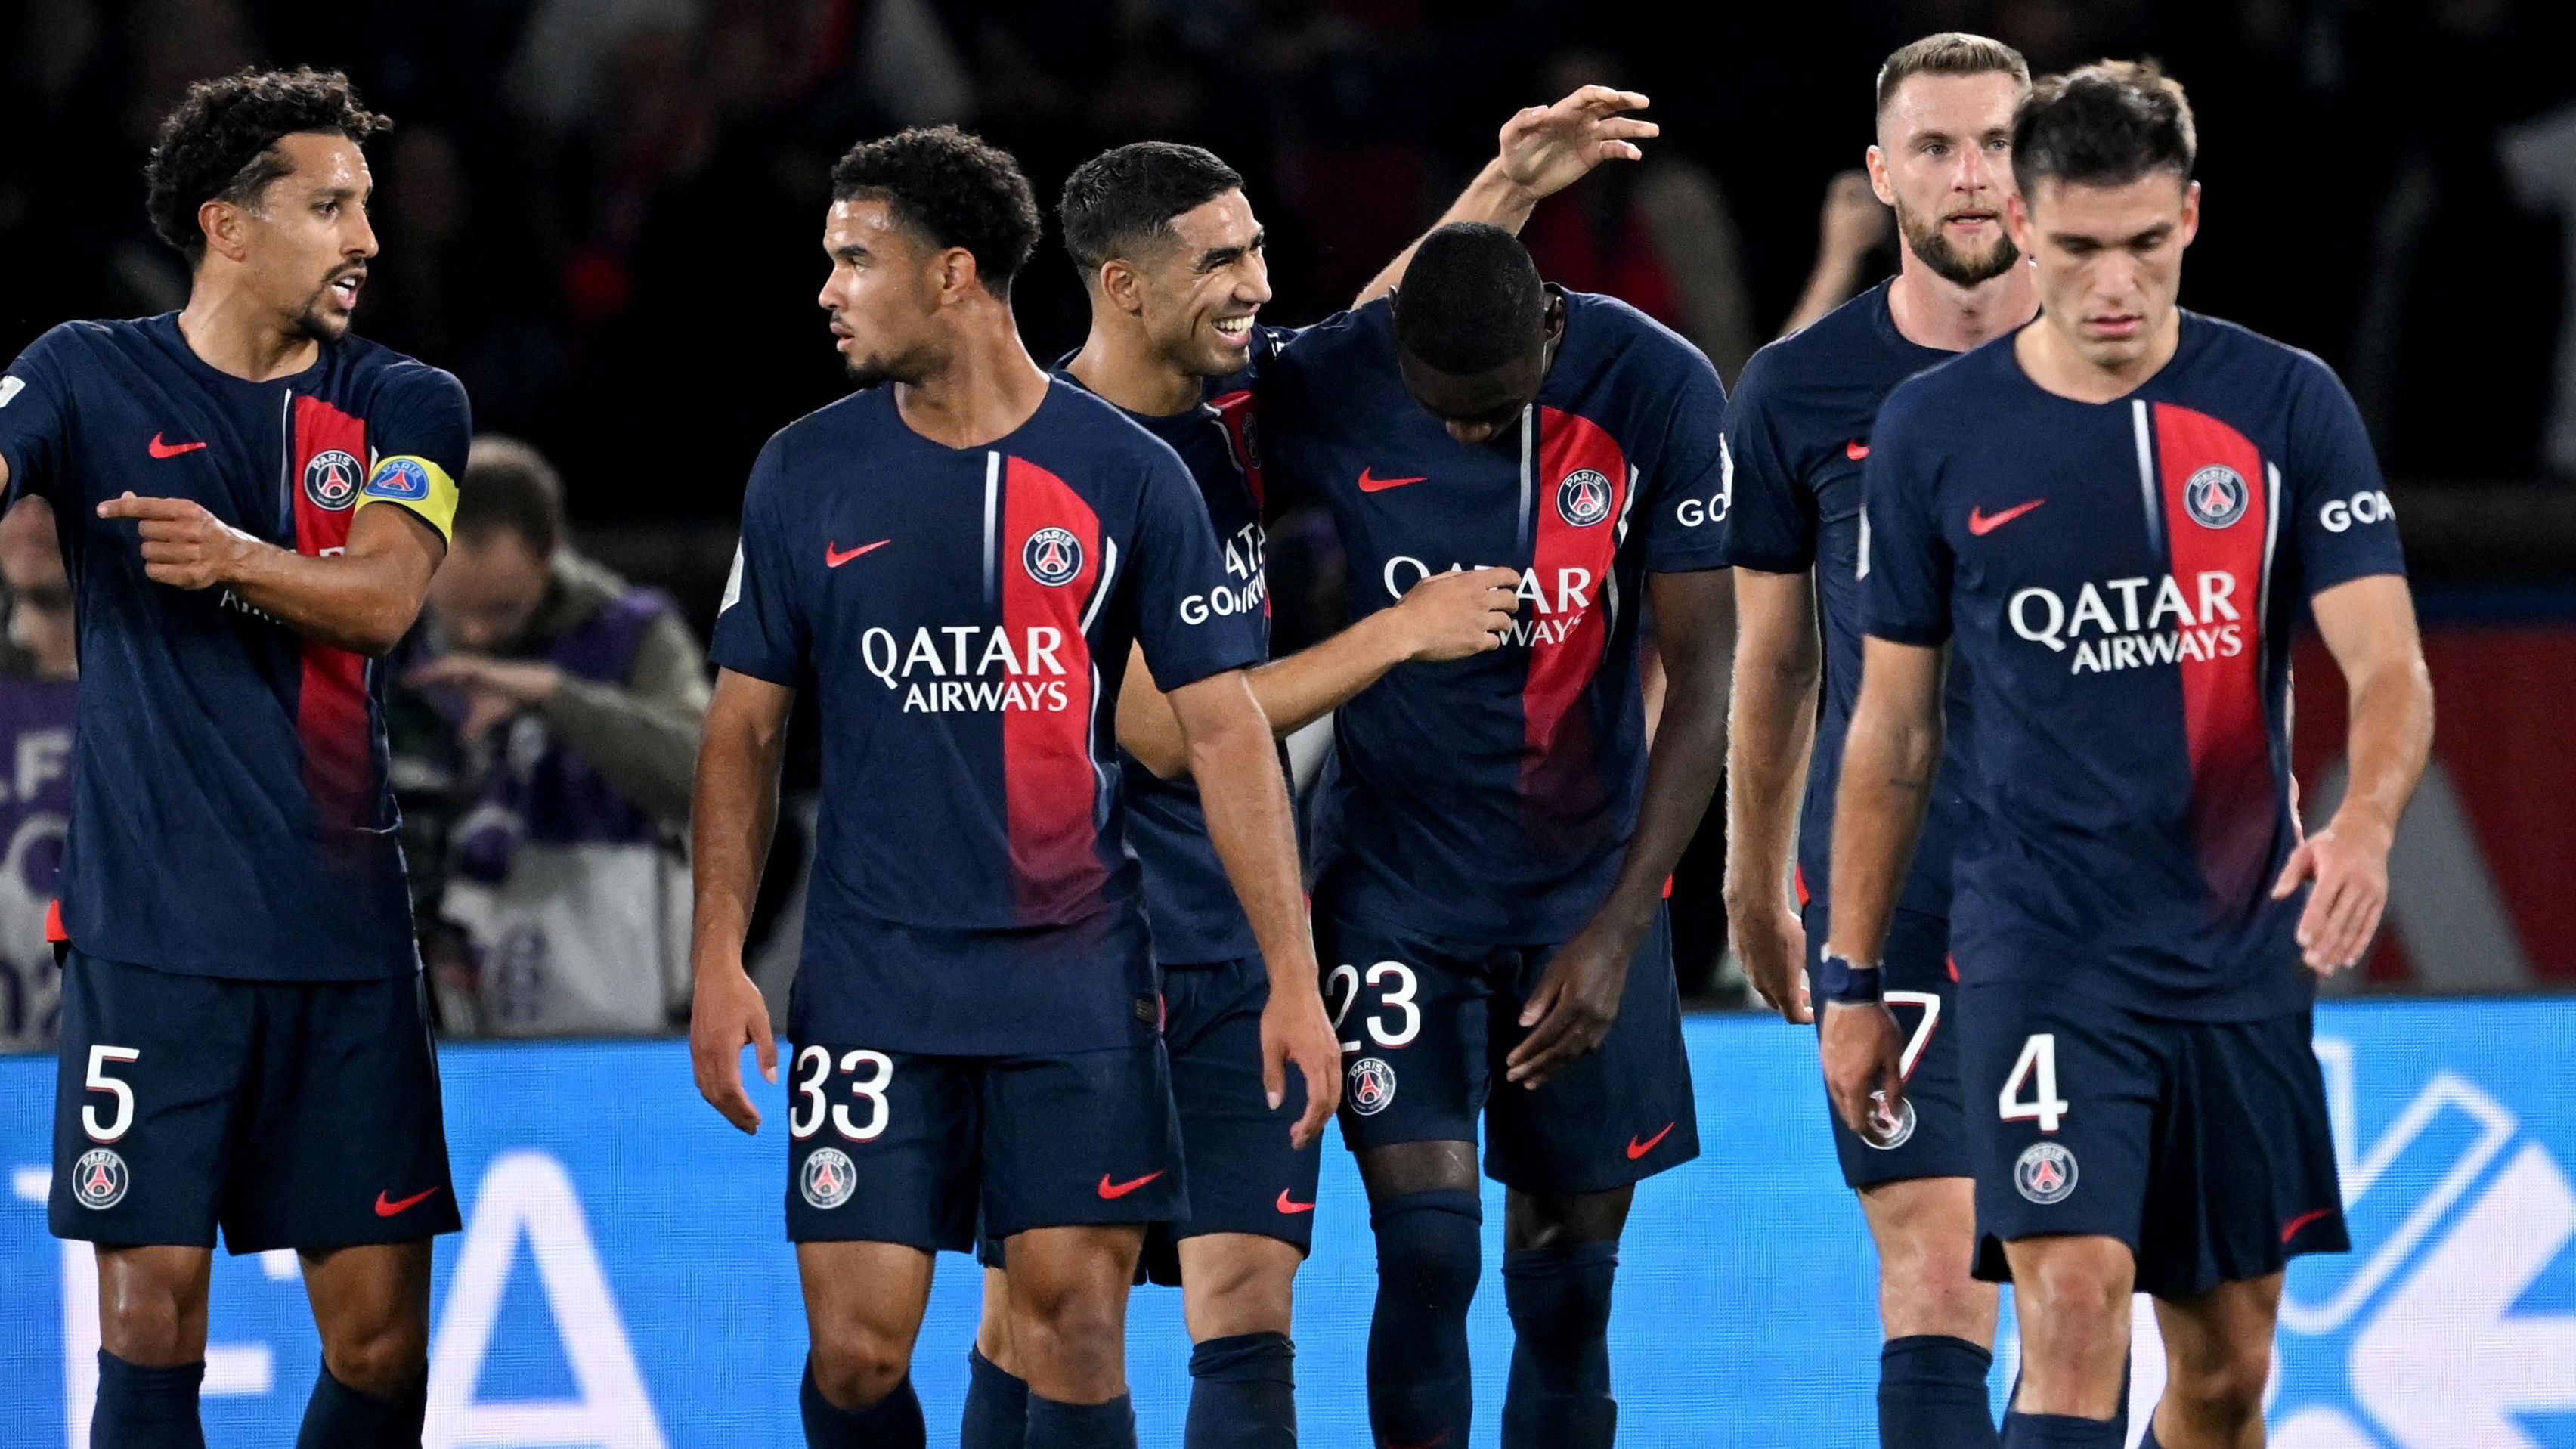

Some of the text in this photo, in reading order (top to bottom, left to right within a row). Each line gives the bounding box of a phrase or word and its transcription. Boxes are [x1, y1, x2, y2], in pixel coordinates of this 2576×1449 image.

[311, 453, 351, 470] PARIS
[382, 463, 423, 479] PARIS
[1565, 472, 1602, 488] PARIS
[1034, 531, 1073, 546] PARIS
[1384, 556, 1590, 615] QAR
[2008, 571, 2241, 653] QATAR
[862, 626, 1067, 689] QATAR
[2071, 624, 2242, 675] AIRWAYS
[903, 681, 1068, 714] AIRWAYS
[1325, 961, 1421, 1053] 23
[1351, 1060, 1383, 1078] PARIS
[1999, 1033, 2069, 1134] 4
[82, 1045, 140, 1144] 5
[790, 1045, 894, 1142] 33
[82, 1152, 119, 1168] PARIS
[809, 1153, 846, 1167] PARIS
